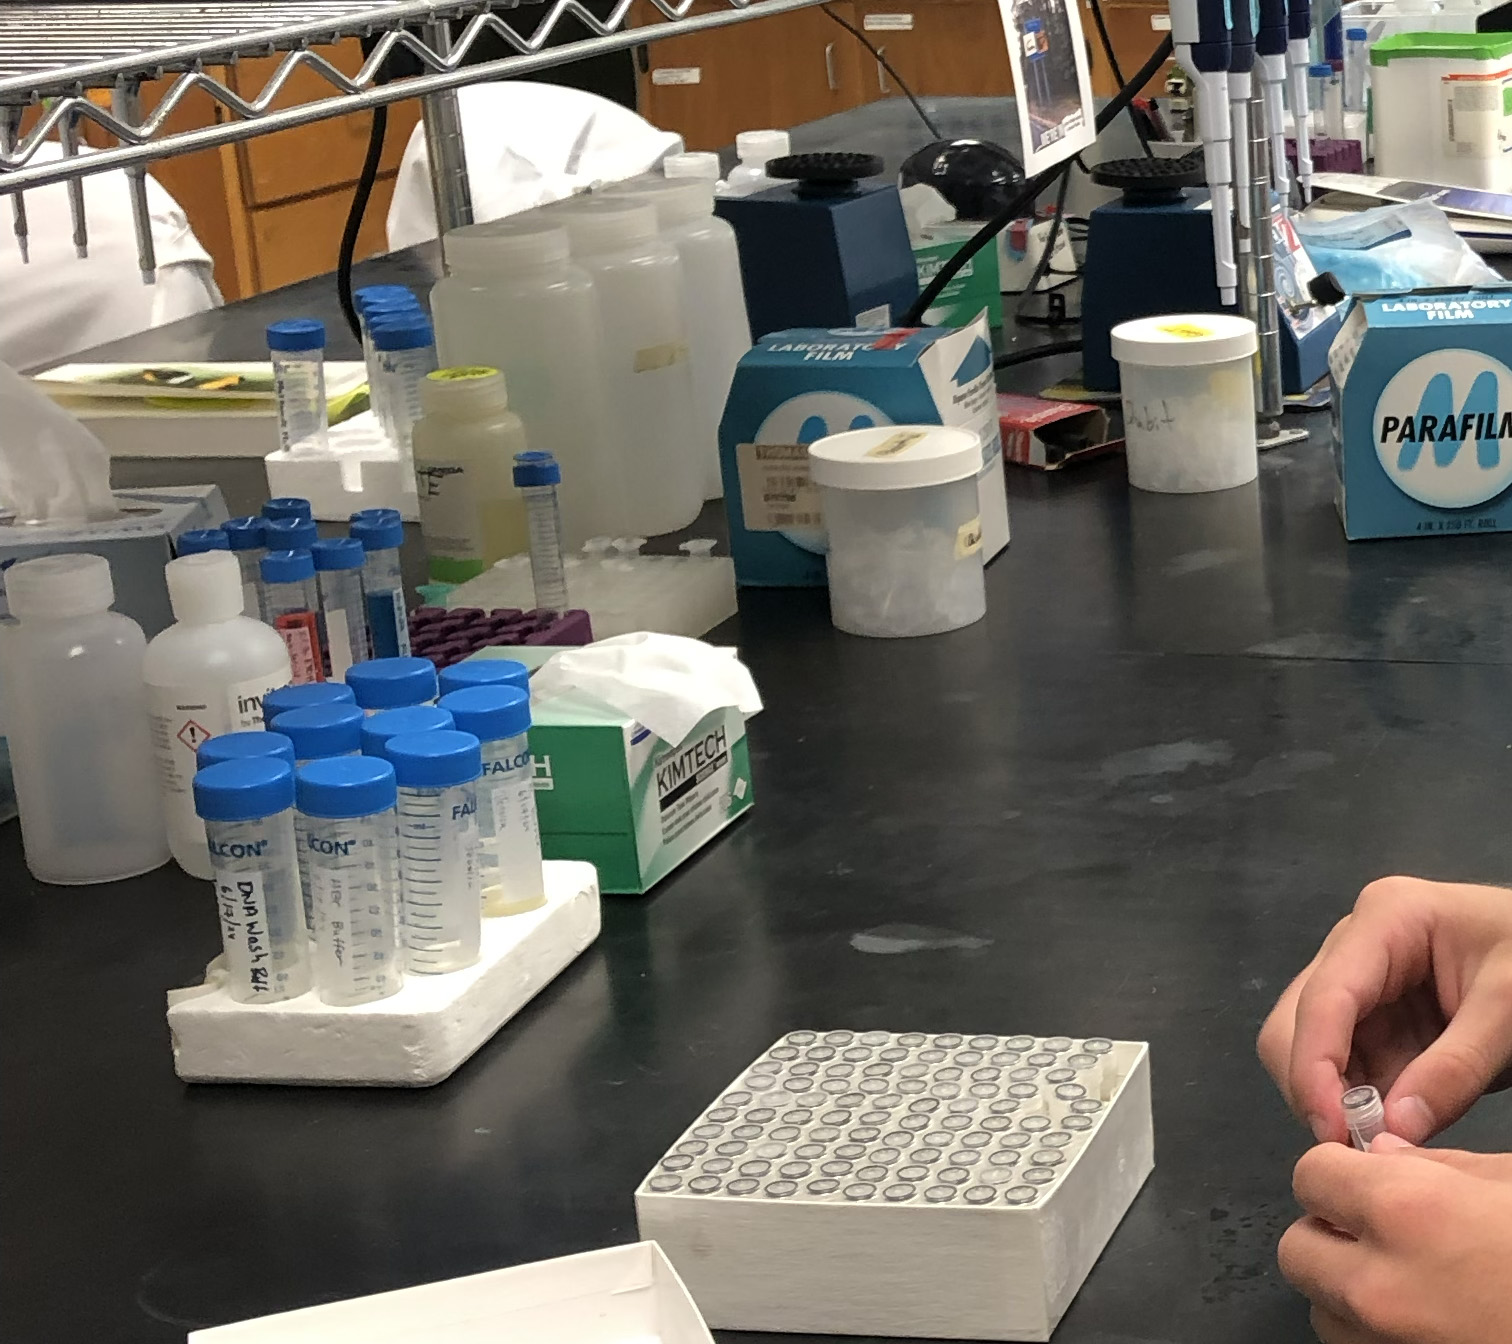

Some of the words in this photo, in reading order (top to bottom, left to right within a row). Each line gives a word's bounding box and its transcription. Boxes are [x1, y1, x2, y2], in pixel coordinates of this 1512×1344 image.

[1382, 299, 1512, 313] LABORATORY
[1427, 309, 1474, 320] FILM
[767, 342, 907, 353] LABORATOY
[803, 350, 854, 361] FILM
[656, 725, 727, 798] KIMTECH
[246, 921, 269, 963] Wash
